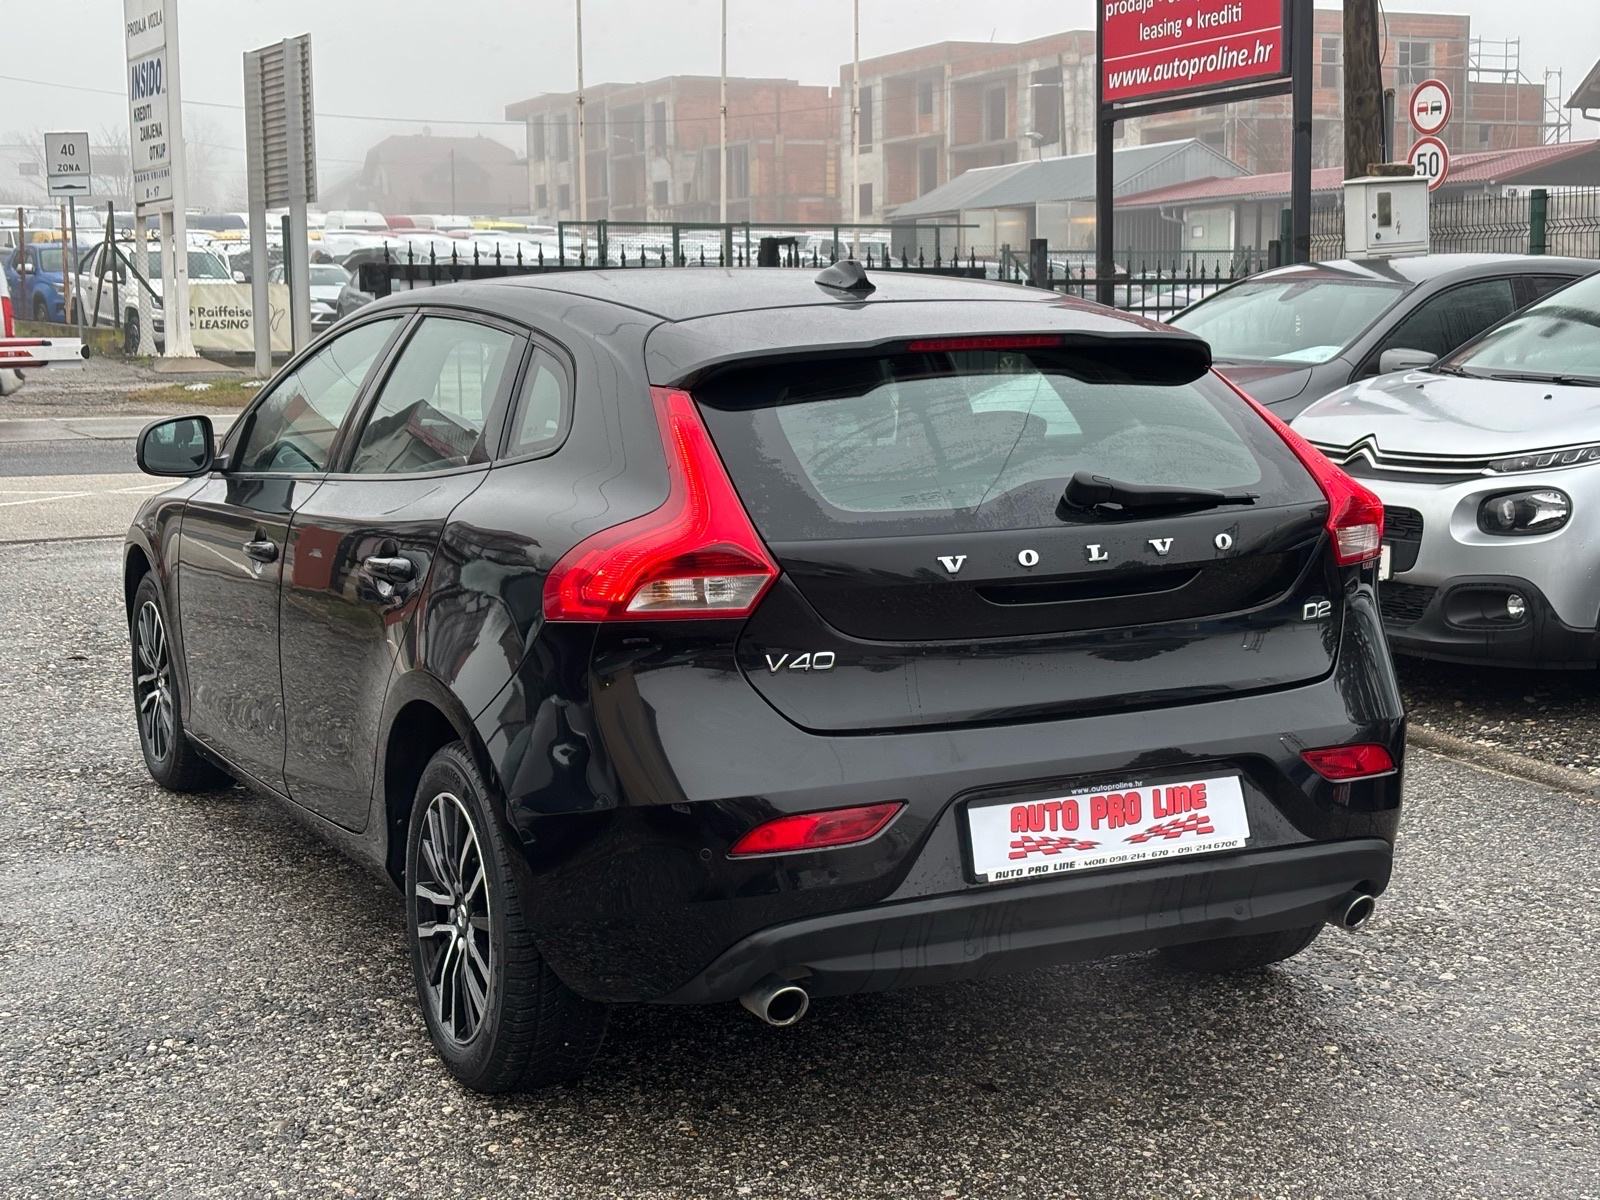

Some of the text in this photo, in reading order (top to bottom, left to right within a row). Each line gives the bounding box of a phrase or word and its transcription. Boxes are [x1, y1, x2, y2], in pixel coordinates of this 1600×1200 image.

[1105, 0, 1154, 21] prodaja
[127, 18, 147, 38] PRODAJA
[1139, 3, 1242, 41] leasing krediti
[1108, 40, 1273, 89] www.autoproline.hr
[131, 58, 162, 101] INSIDO
[133, 103, 152, 123] KREDITI
[140, 121, 163, 142] ZAMJENA
[60, 143, 75, 156] 40
[149, 143, 166, 160] OTKUP
[57, 163, 81, 172] ZONA
[1416, 151, 1440, 177] 50
[153, 185, 160, 197] 17
[197, 305, 252, 317] Raiffeise
[199, 319, 249, 330] LEASING
[937, 532, 1233, 574] VOLVO
[1303, 600, 1331, 620] D2
[765, 651, 835, 673] V40
[1070, 780, 1143, 795] www.autoproline.hr
[1010, 783, 1207, 833] AUTO PRO LINE
[995, 868, 1023, 879] AUTO
[1027, 864, 1049, 875] PRO
[1053, 860, 1076, 871] LINE
